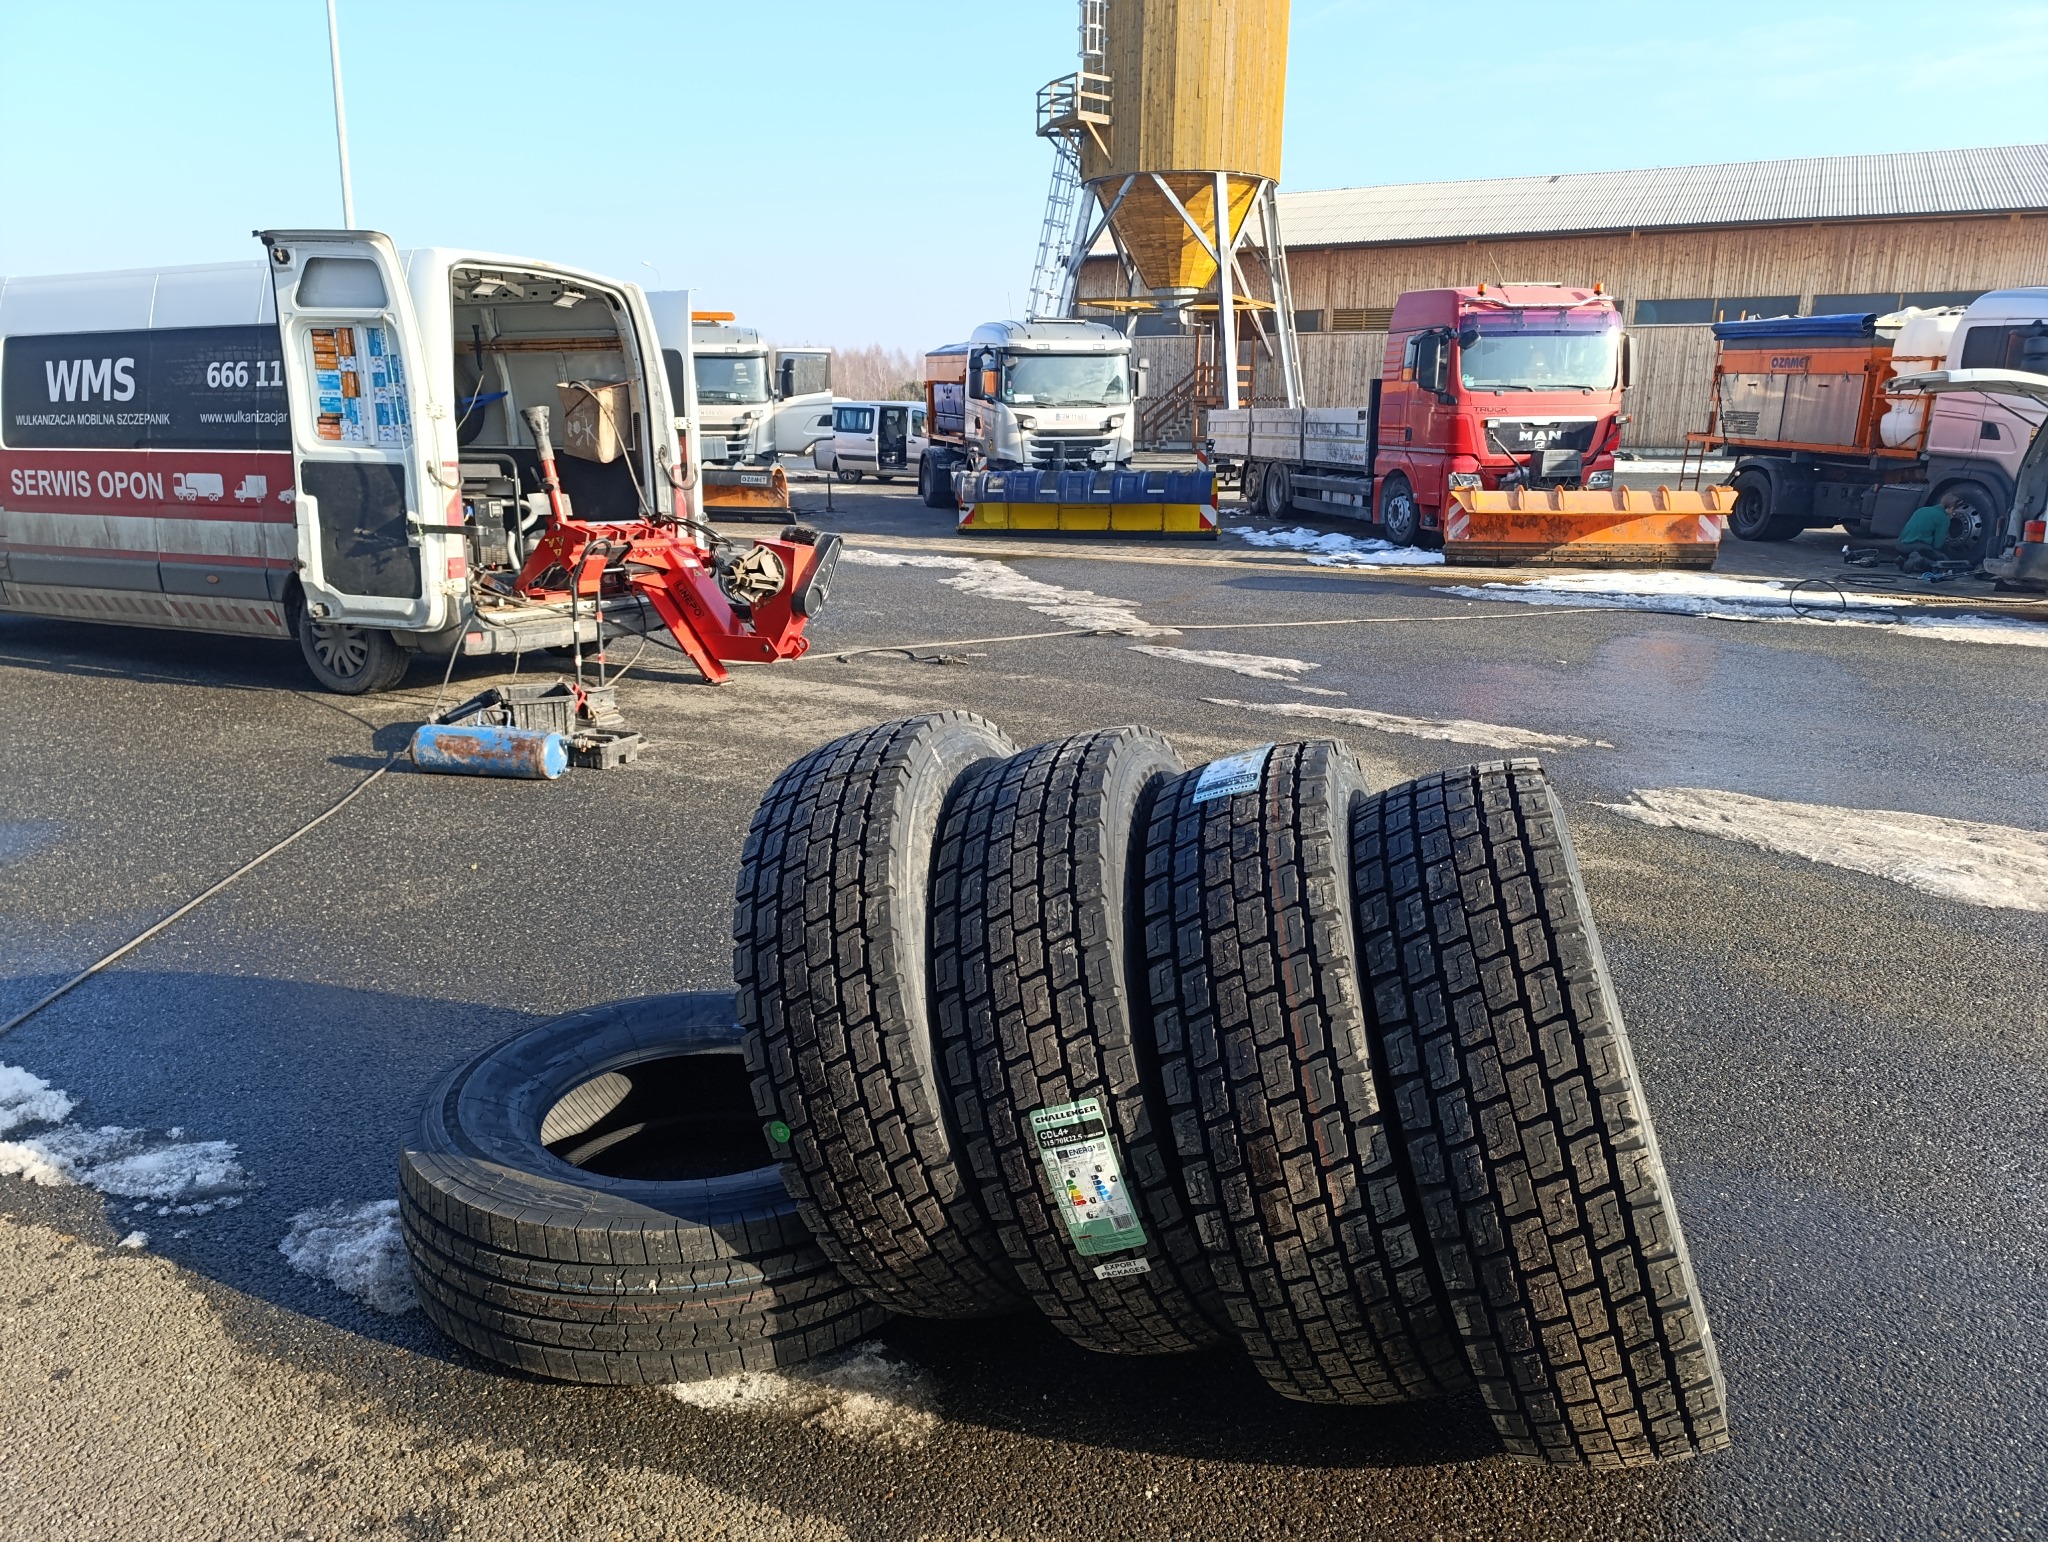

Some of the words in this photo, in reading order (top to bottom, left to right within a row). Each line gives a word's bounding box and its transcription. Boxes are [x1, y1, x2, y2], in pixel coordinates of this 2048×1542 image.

[1771, 356, 1811, 369] OZAMET
[45, 357, 136, 402] WMS
[206, 361, 249, 388] 666
[15, 413, 76, 426] WULKANIZACJA
[77, 413, 115, 426] MOBILNA
[116, 413, 171, 425] SZCZEPANIK
[1519, 430, 1562, 441] MAN
[10, 468, 92, 498] SERWIS
[97, 470, 164, 500] OPON
[1035, 1105, 1097, 1124] CHALLENGER
[1040, 1128, 1069, 1140] CDL4+
[1101, 1266, 1147, 1277] PACKAGES
[1104, 1261, 1137, 1270] EXPORT
